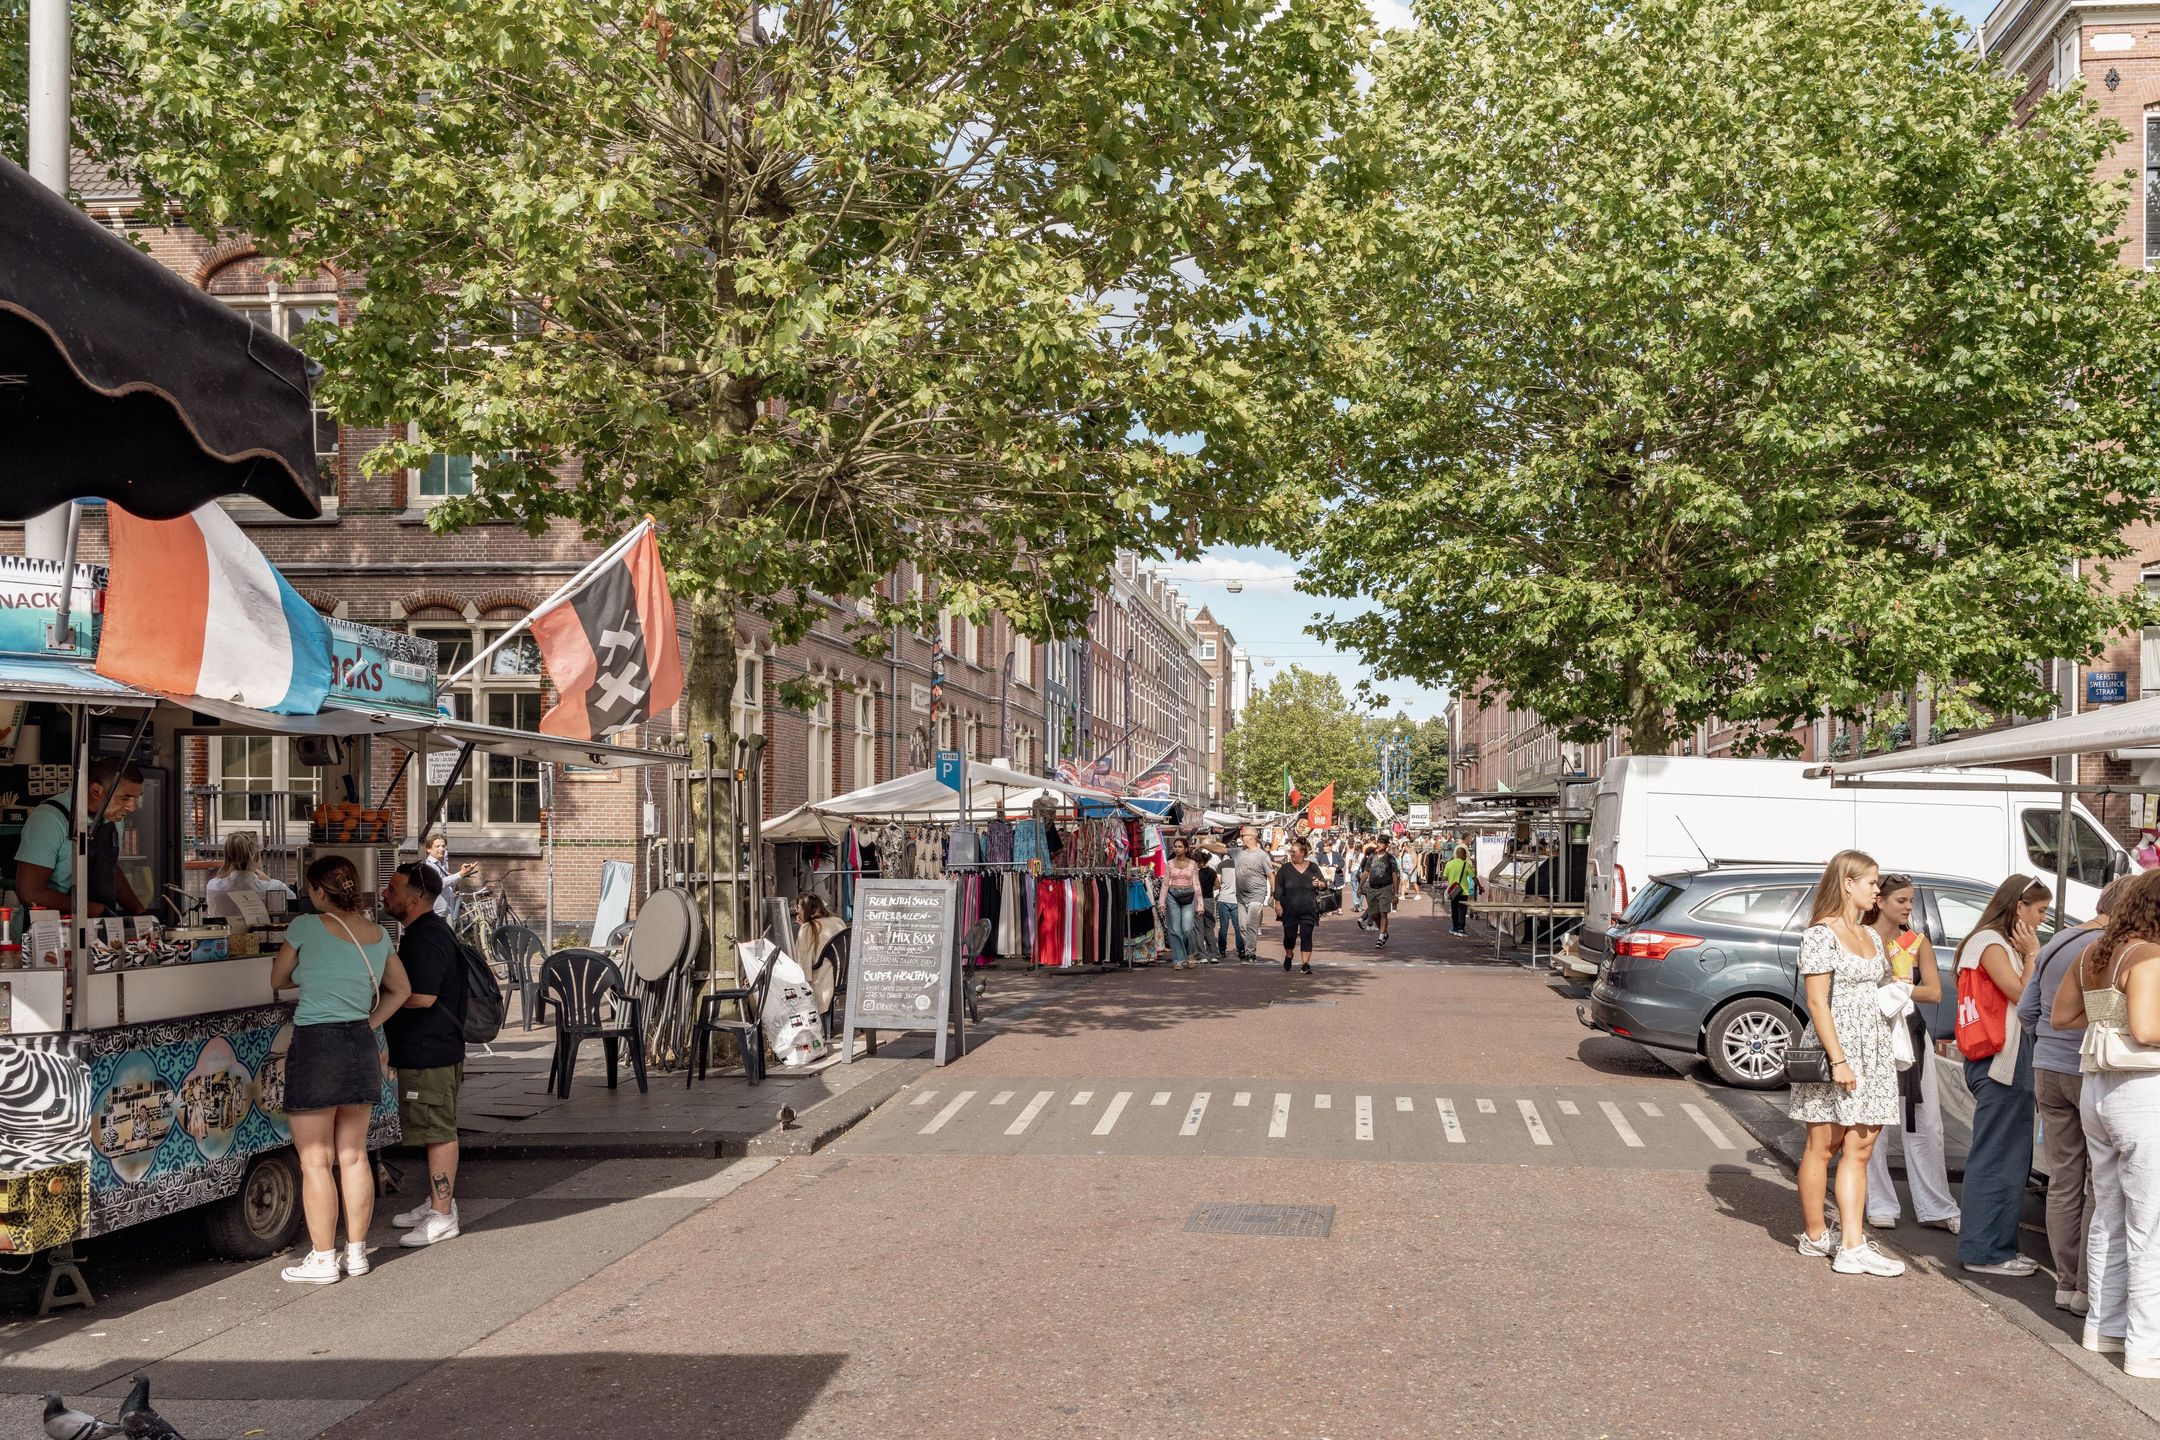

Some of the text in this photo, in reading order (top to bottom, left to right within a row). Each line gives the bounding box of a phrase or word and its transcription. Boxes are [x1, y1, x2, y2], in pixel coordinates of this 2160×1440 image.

[943, 762, 953, 778] P
[869, 895, 940, 907] REAL DUTCH SNACKS
[892, 931, 910, 944] MIX
[913, 932, 935, 945] BOX
[863, 970, 892, 982] SUPER
